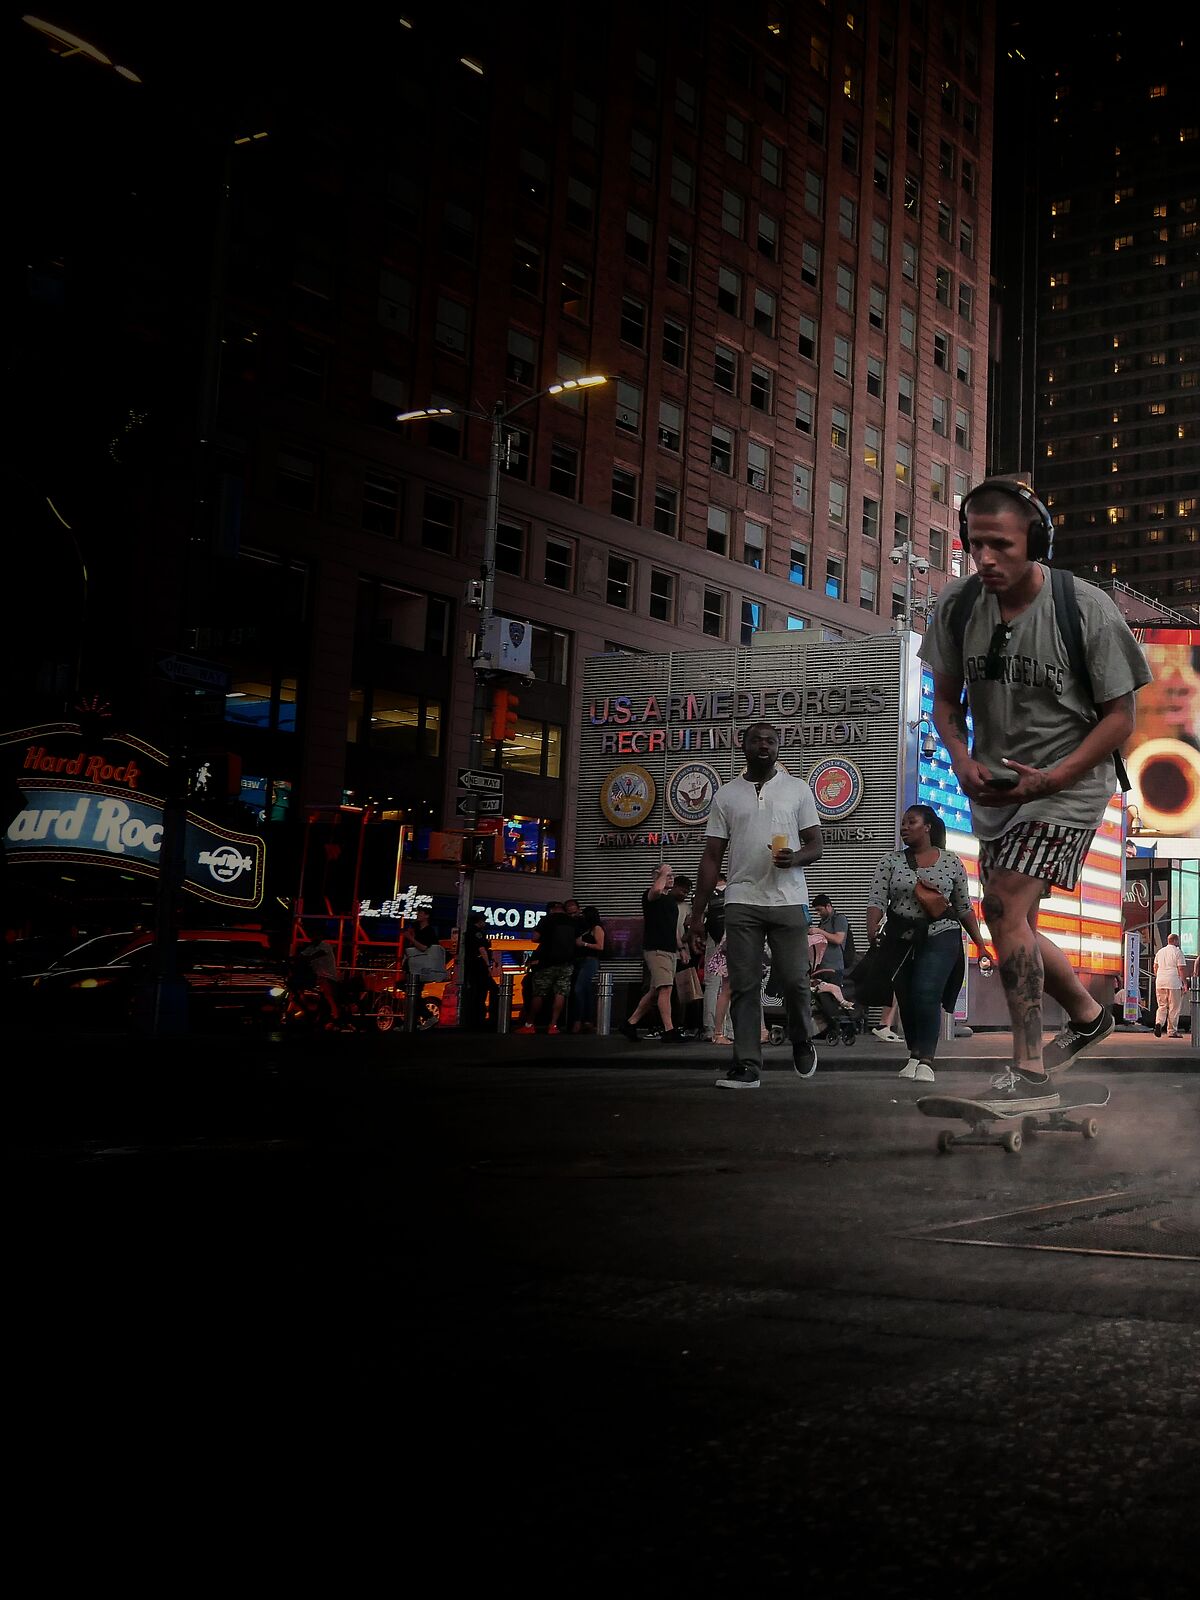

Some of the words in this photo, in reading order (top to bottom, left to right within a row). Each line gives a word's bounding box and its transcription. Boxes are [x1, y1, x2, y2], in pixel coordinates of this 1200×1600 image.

[1000, 655, 1065, 696] NGELES
[590, 696, 638, 725] U.S.
[640, 690, 755, 722] ARMED
[759, 684, 886, 718] FORCES
[776, 721, 868, 747] TATION
[23, 744, 87, 776] Hard
[85, 755, 143, 788] Rock
[483, 778, 498, 788] WAY
[647, 831, 692, 847] NAVY
[824, 827, 865, 841] RINES
[472, 905, 521, 928] TACO
